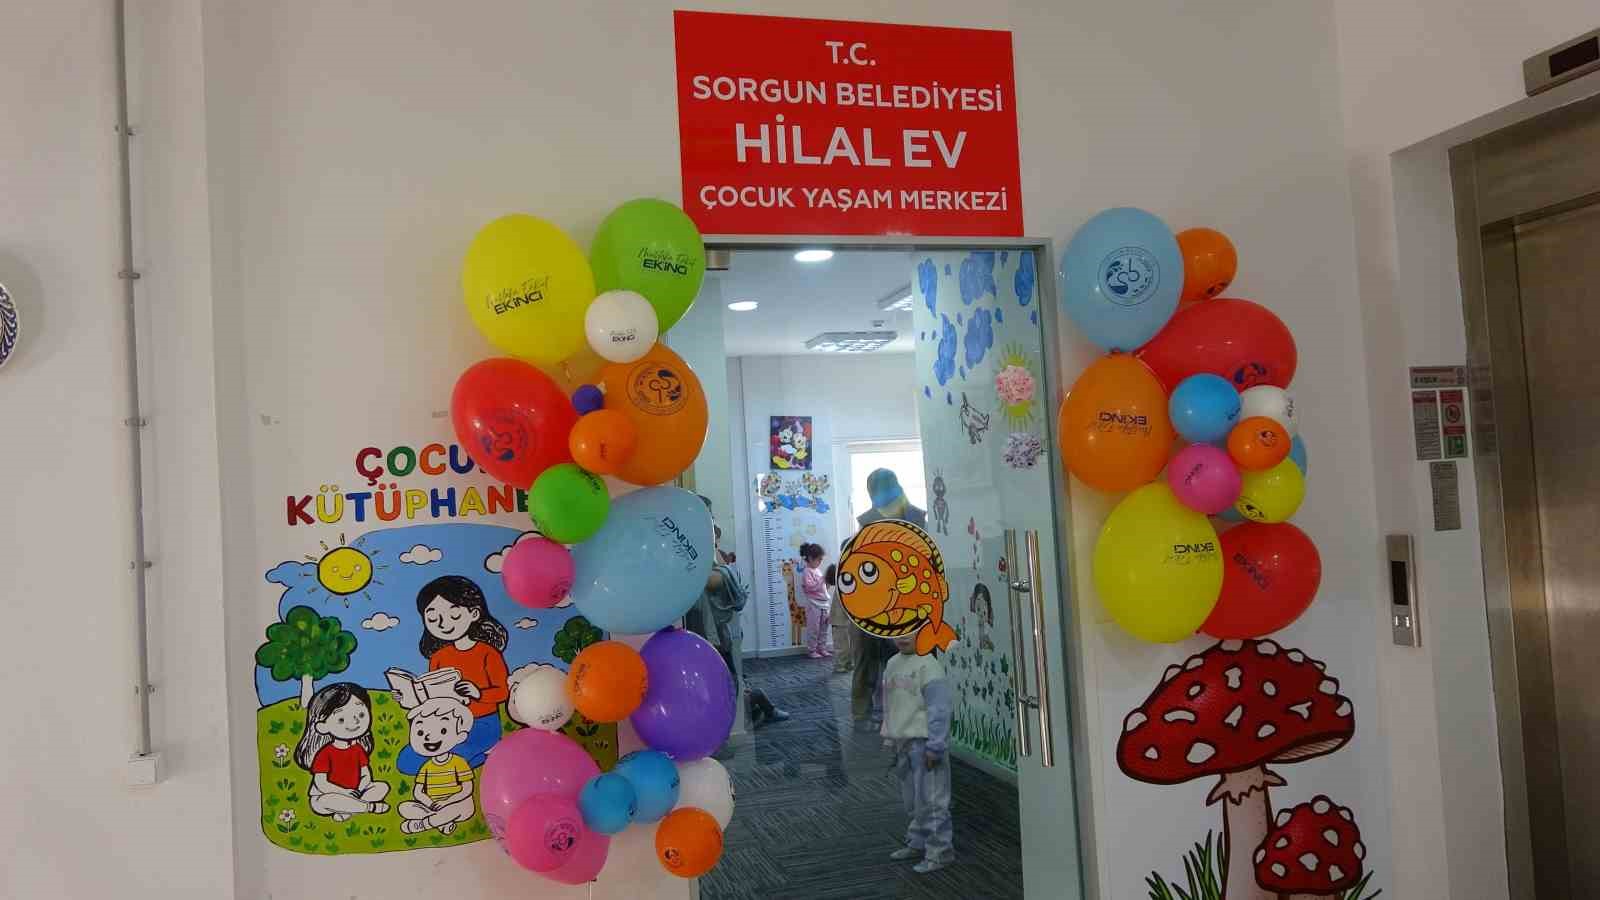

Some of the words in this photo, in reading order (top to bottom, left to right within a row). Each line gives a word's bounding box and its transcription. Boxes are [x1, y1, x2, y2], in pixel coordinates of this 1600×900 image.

[825, 40, 876, 66] T.C.
[692, 75, 827, 105] SORGUN
[836, 81, 1003, 112] BELEDİYESİ
[735, 114, 892, 167] HİLAL
[902, 129, 967, 169] EV
[700, 185, 795, 209] ÇOCUK
[801, 188, 893, 212] YAŞAM
[900, 187, 1008, 212] MERKEZİ
[355, 443, 486, 486] ÇOCU
